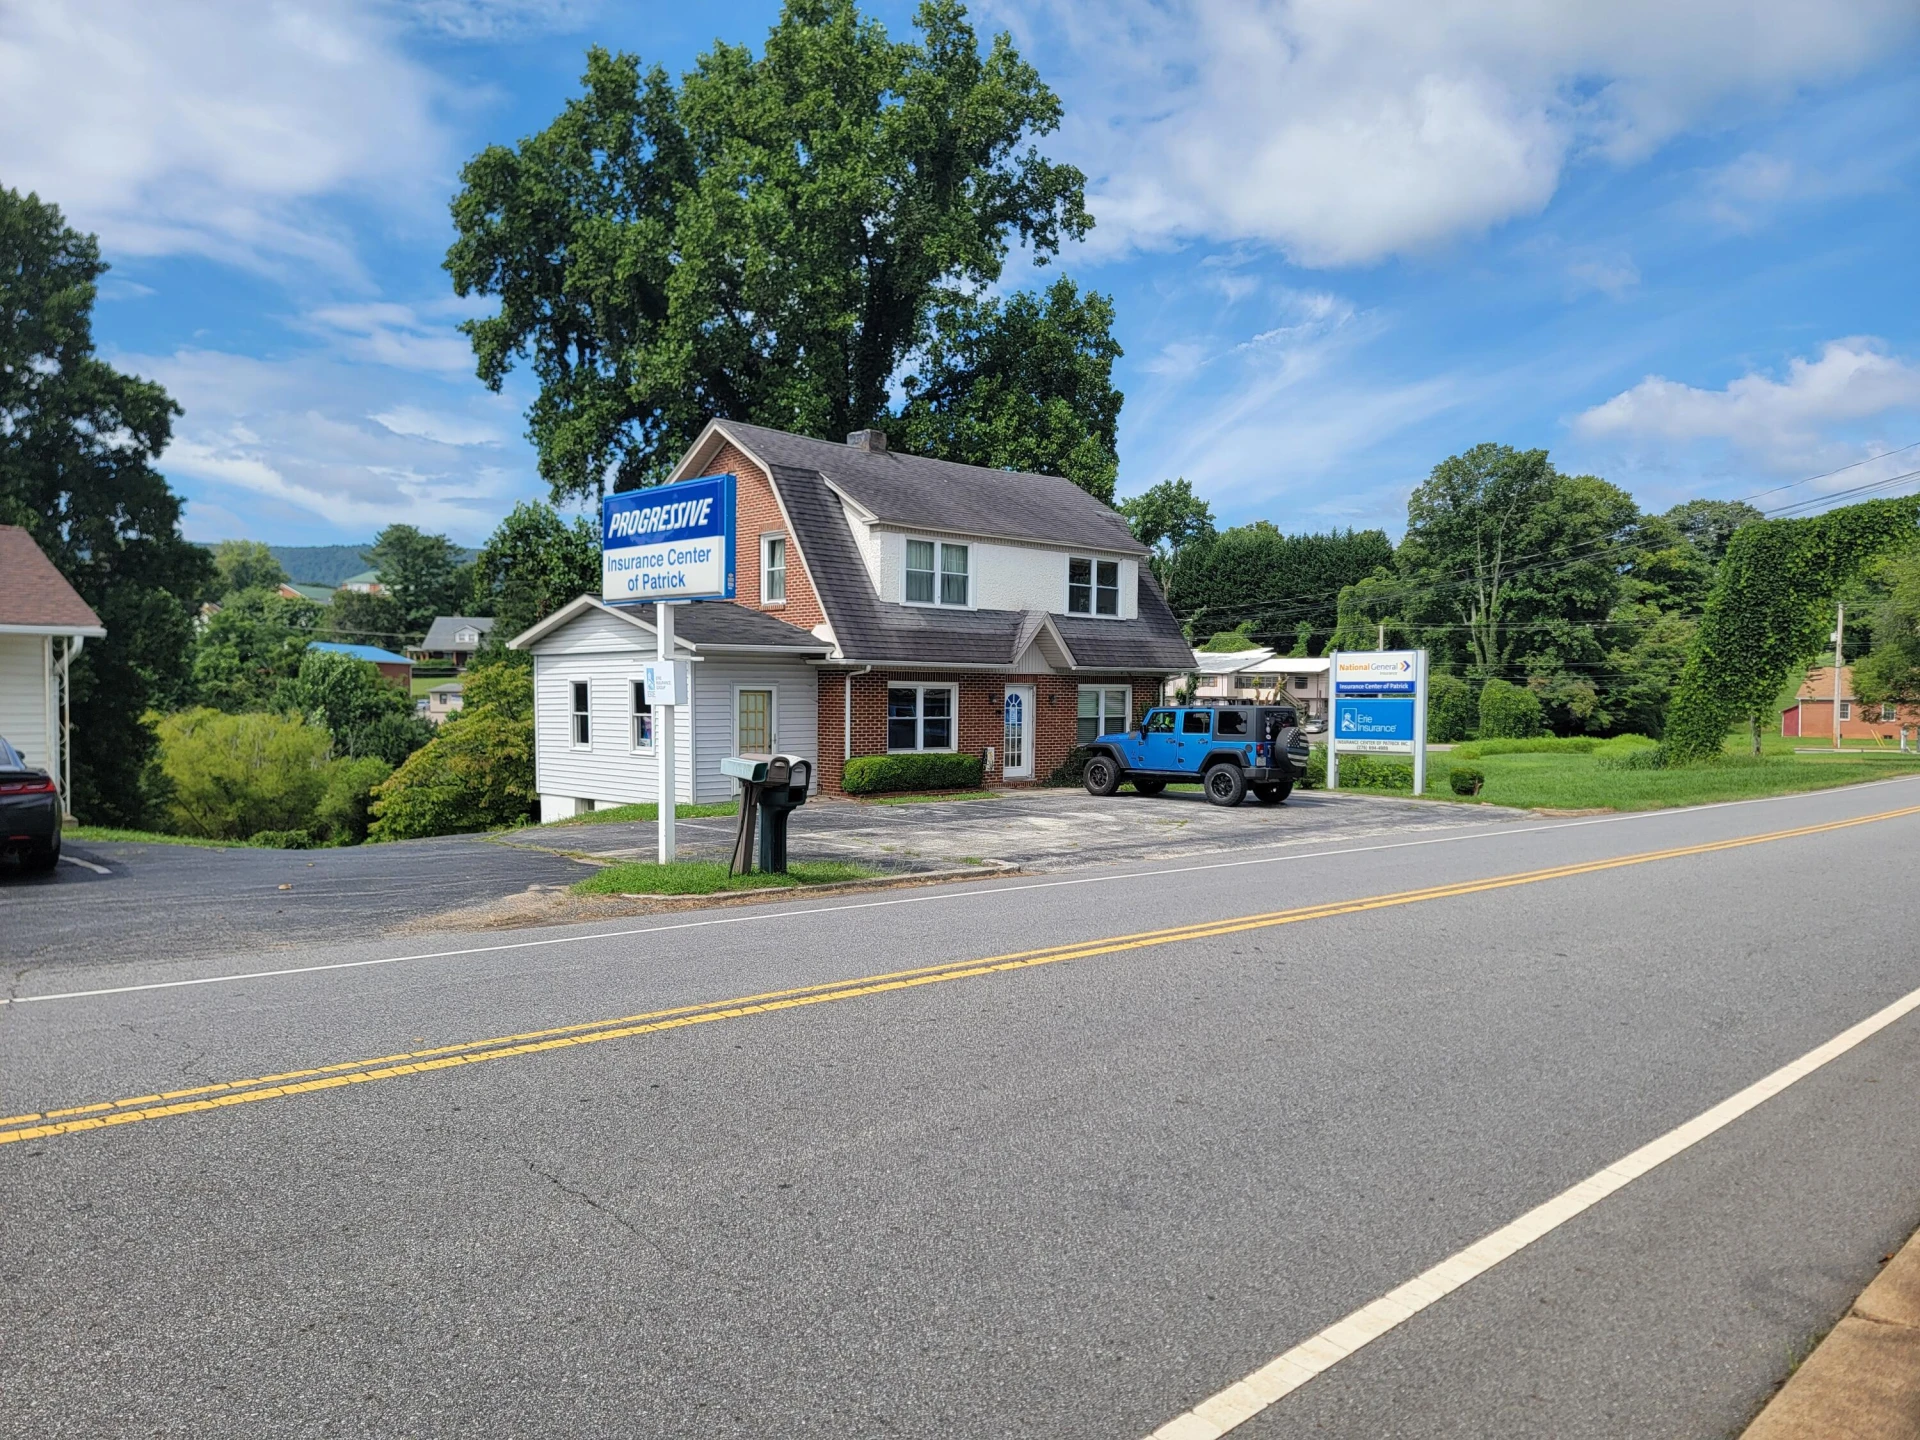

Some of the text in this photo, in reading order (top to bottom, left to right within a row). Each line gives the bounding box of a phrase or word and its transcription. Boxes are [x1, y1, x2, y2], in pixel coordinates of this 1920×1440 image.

[608, 497, 713, 539] PROGRESSIVE
[607, 547, 711, 572] Insurance Center
[627, 570, 686, 591] of Patrick
[1339, 663, 1398, 671] National General
[1357, 714, 1373, 723] Erie
[1357, 724, 1396, 732] Insurance
